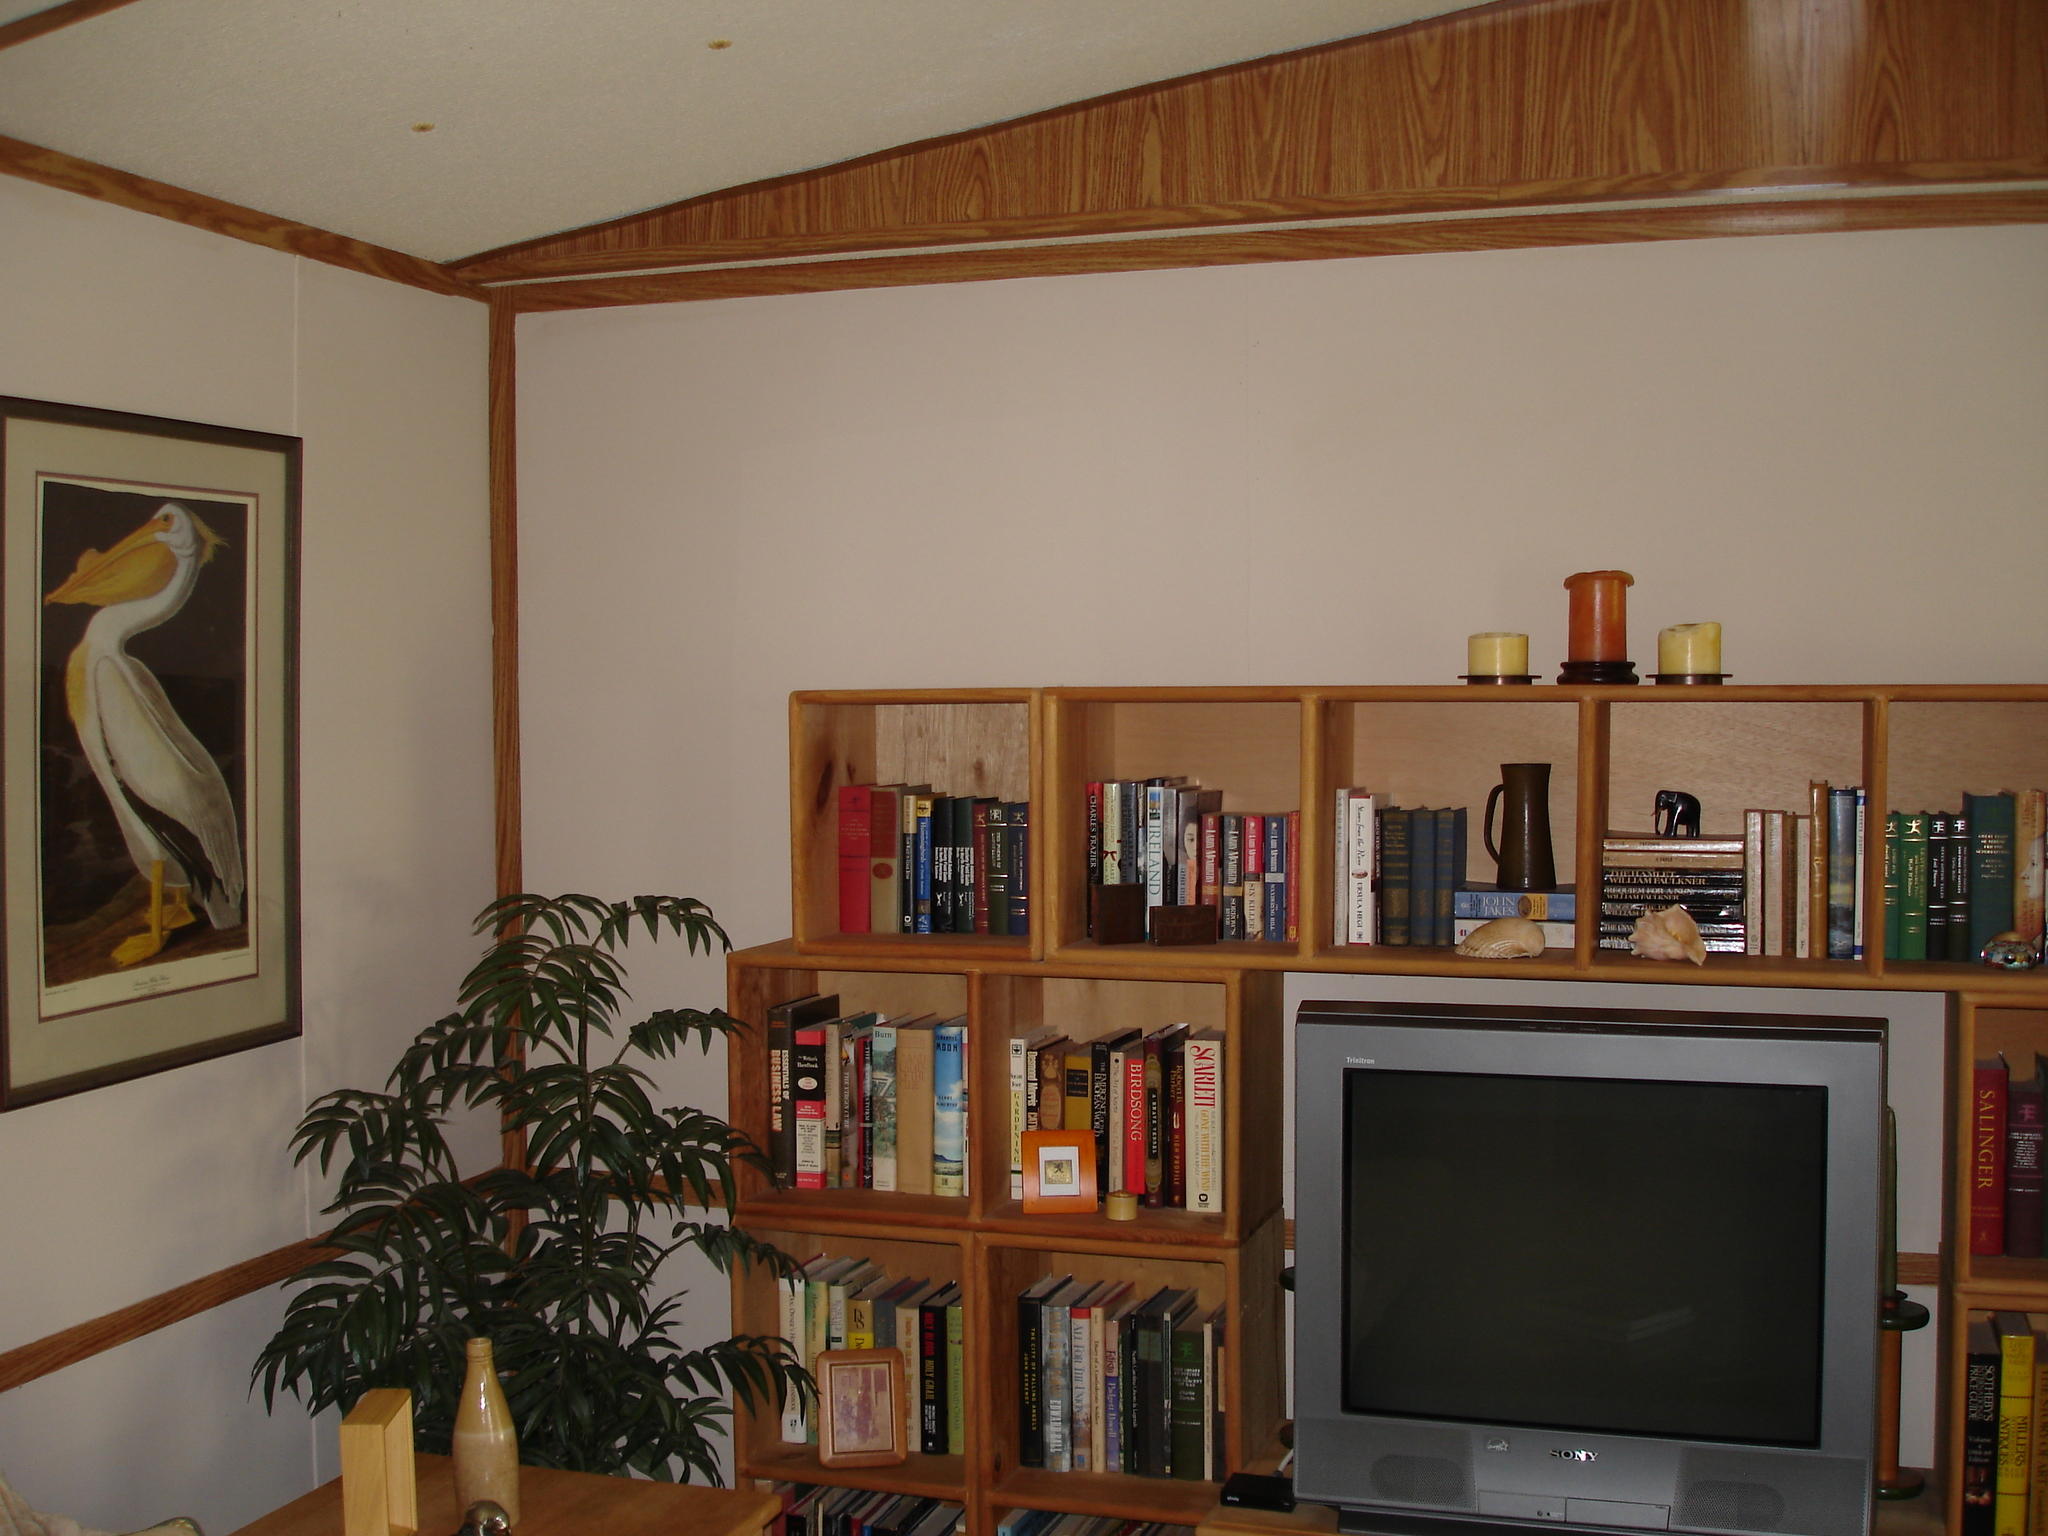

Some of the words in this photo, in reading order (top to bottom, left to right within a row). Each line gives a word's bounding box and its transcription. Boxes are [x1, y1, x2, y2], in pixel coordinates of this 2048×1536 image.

[1149, 825, 1161, 896] IRELAND
[1655, 877, 1706, 885] FAULKNER
[1482, 896, 1516, 906] JOHN
[1484, 907, 1515, 916] JAKES
[936, 1043, 958, 1052] MOON
[771, 1050, 782, 1103] BUSINESS
[1190, 1045, 1216, 1109] SCARLETT
[782, 1090, 789, 1100] OF
[1131, 1064, 1142, 1141] BIRDSONG
[772, 1105, 782, 1132] LAW
[1200, 1110, 1210, 1129] GONE
[1200, 1133, 1210, 1152] WITH
[1978, 1090, 1995, 1189] SALINGER
[1201, 1154, 1210, 1169] THE
[1201, 1171, 1210, 1191] WIND
[1984, 1365, 1995, 1421] SOTHEBY'S
[1050, 1400, 1062, 1431] EDWARD
[1969, 1391, 1978, 1421] GUIDE
[1550, 1450, 1598, 1462] SONY
